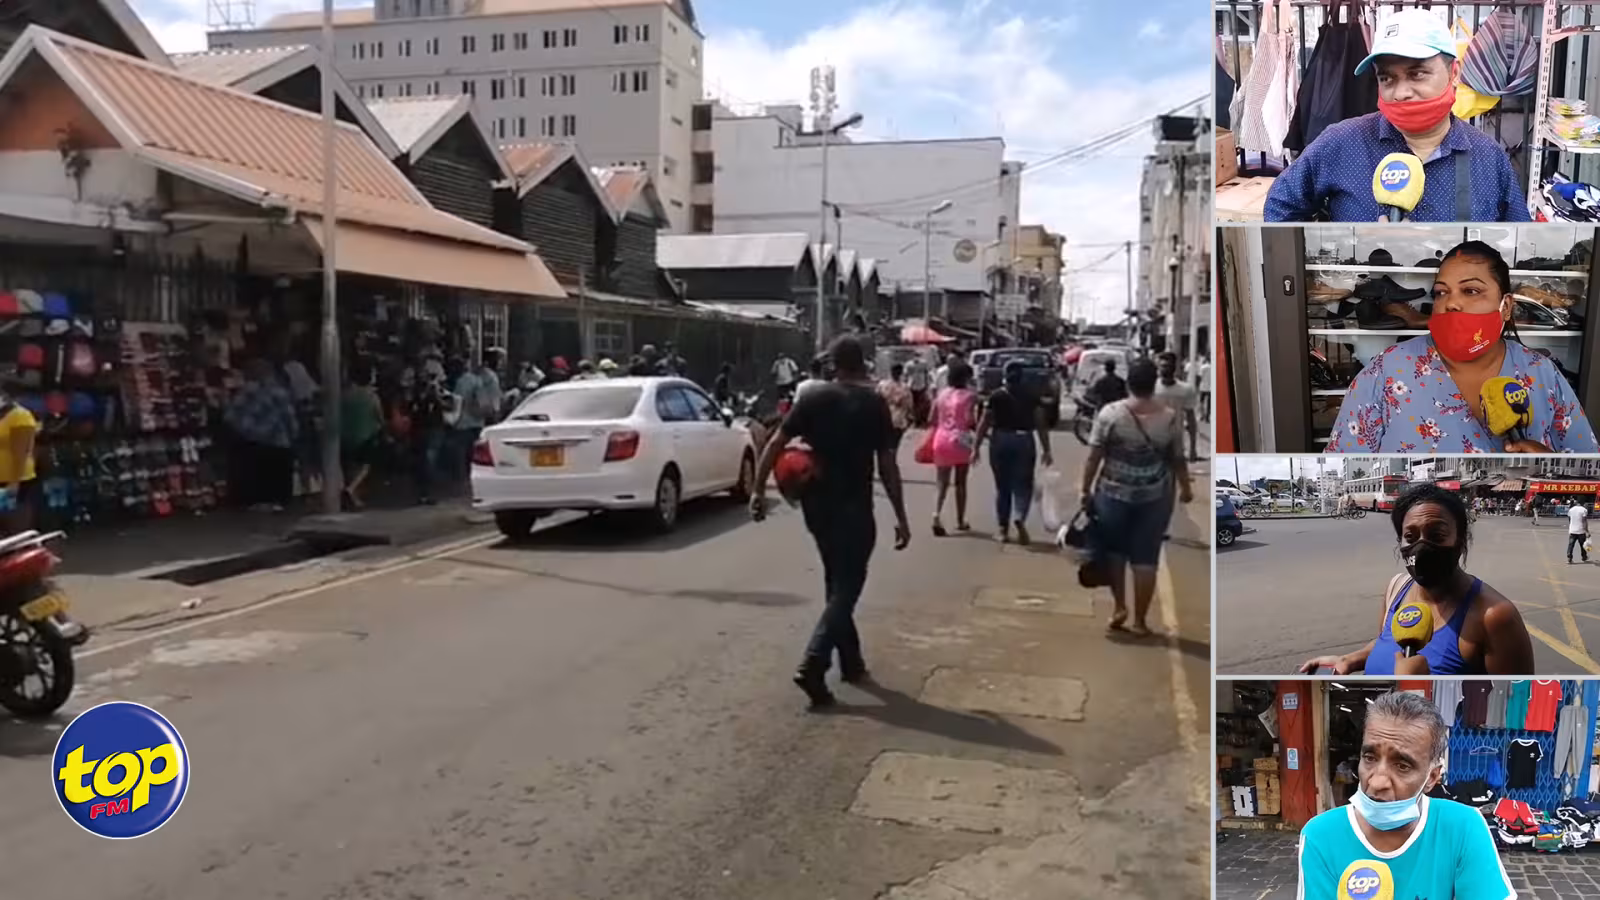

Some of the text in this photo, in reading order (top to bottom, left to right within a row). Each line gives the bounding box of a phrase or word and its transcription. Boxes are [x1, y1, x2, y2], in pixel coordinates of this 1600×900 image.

[1381, 167, 1410, 184] top
[1505, 389, 1527, 404] top
[1398, 610, 1421, 622] top
[1348, 875, 1380, 893] top
